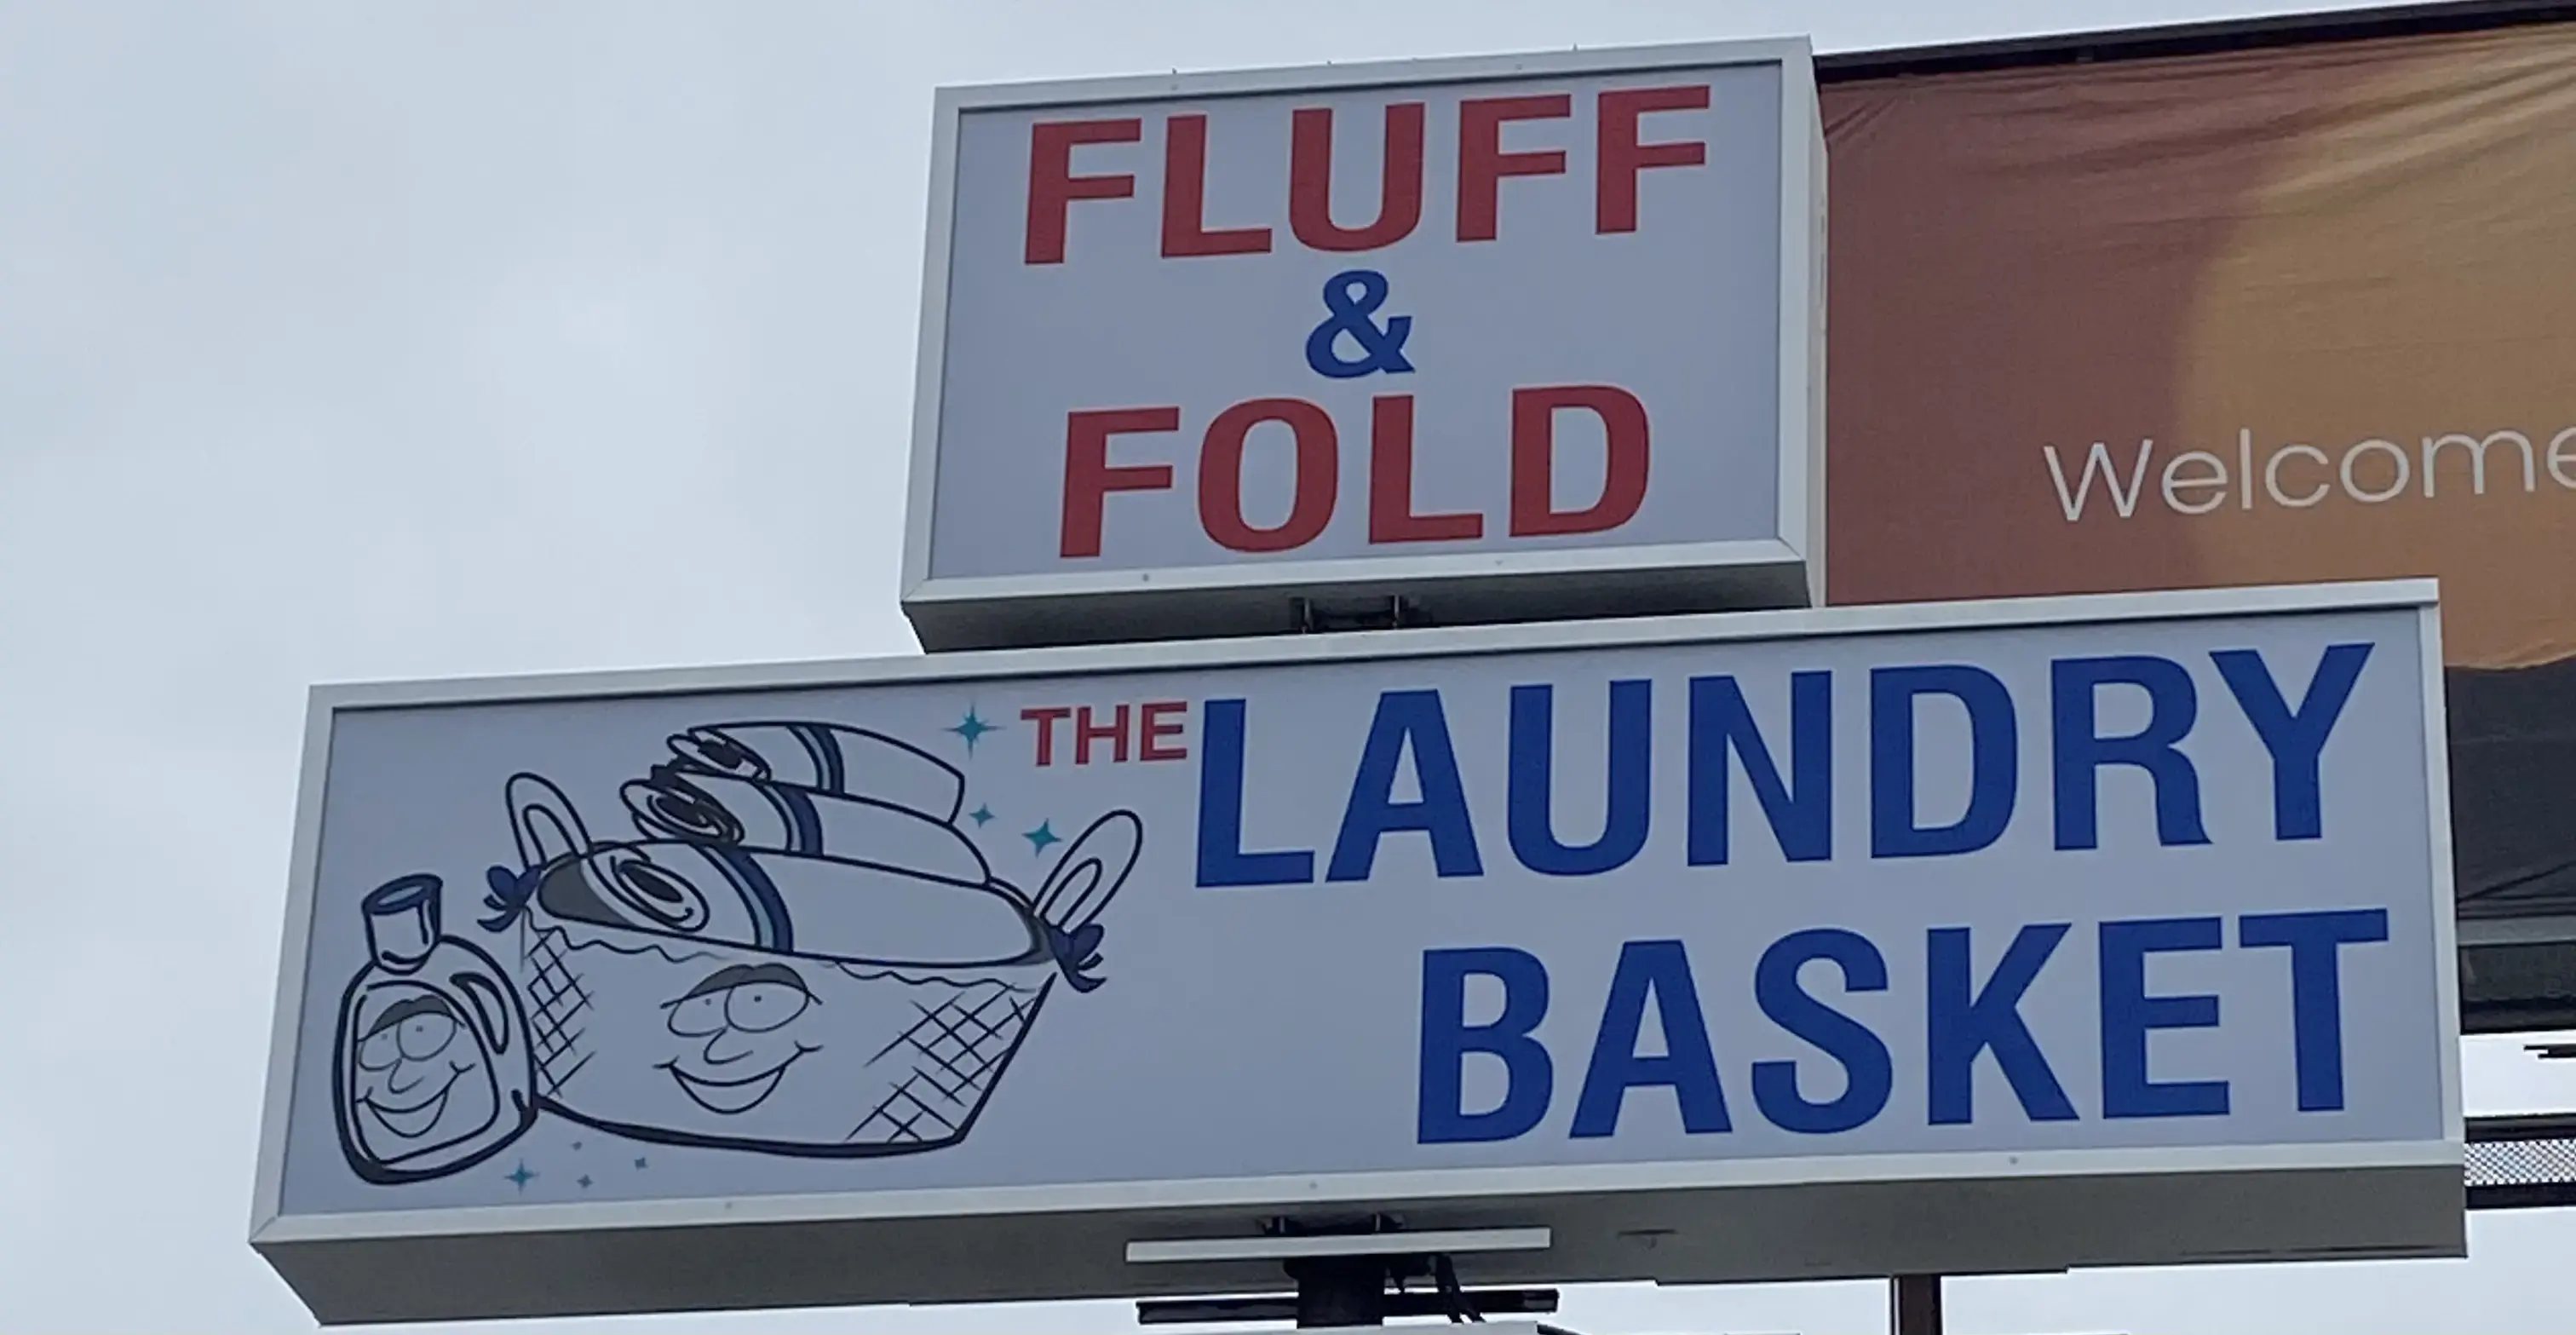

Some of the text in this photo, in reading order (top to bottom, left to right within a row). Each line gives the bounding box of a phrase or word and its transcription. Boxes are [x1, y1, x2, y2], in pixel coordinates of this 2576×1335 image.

[1024, 85, 1711, 264] FLUFF
[1304, 268, 1415, 379] &
[1059, 383, 1651, 559] FOLD
[1021, 641, 2375, 889] THE LAUNDRY
[1416, 906, 2390, 1147] BASKET
